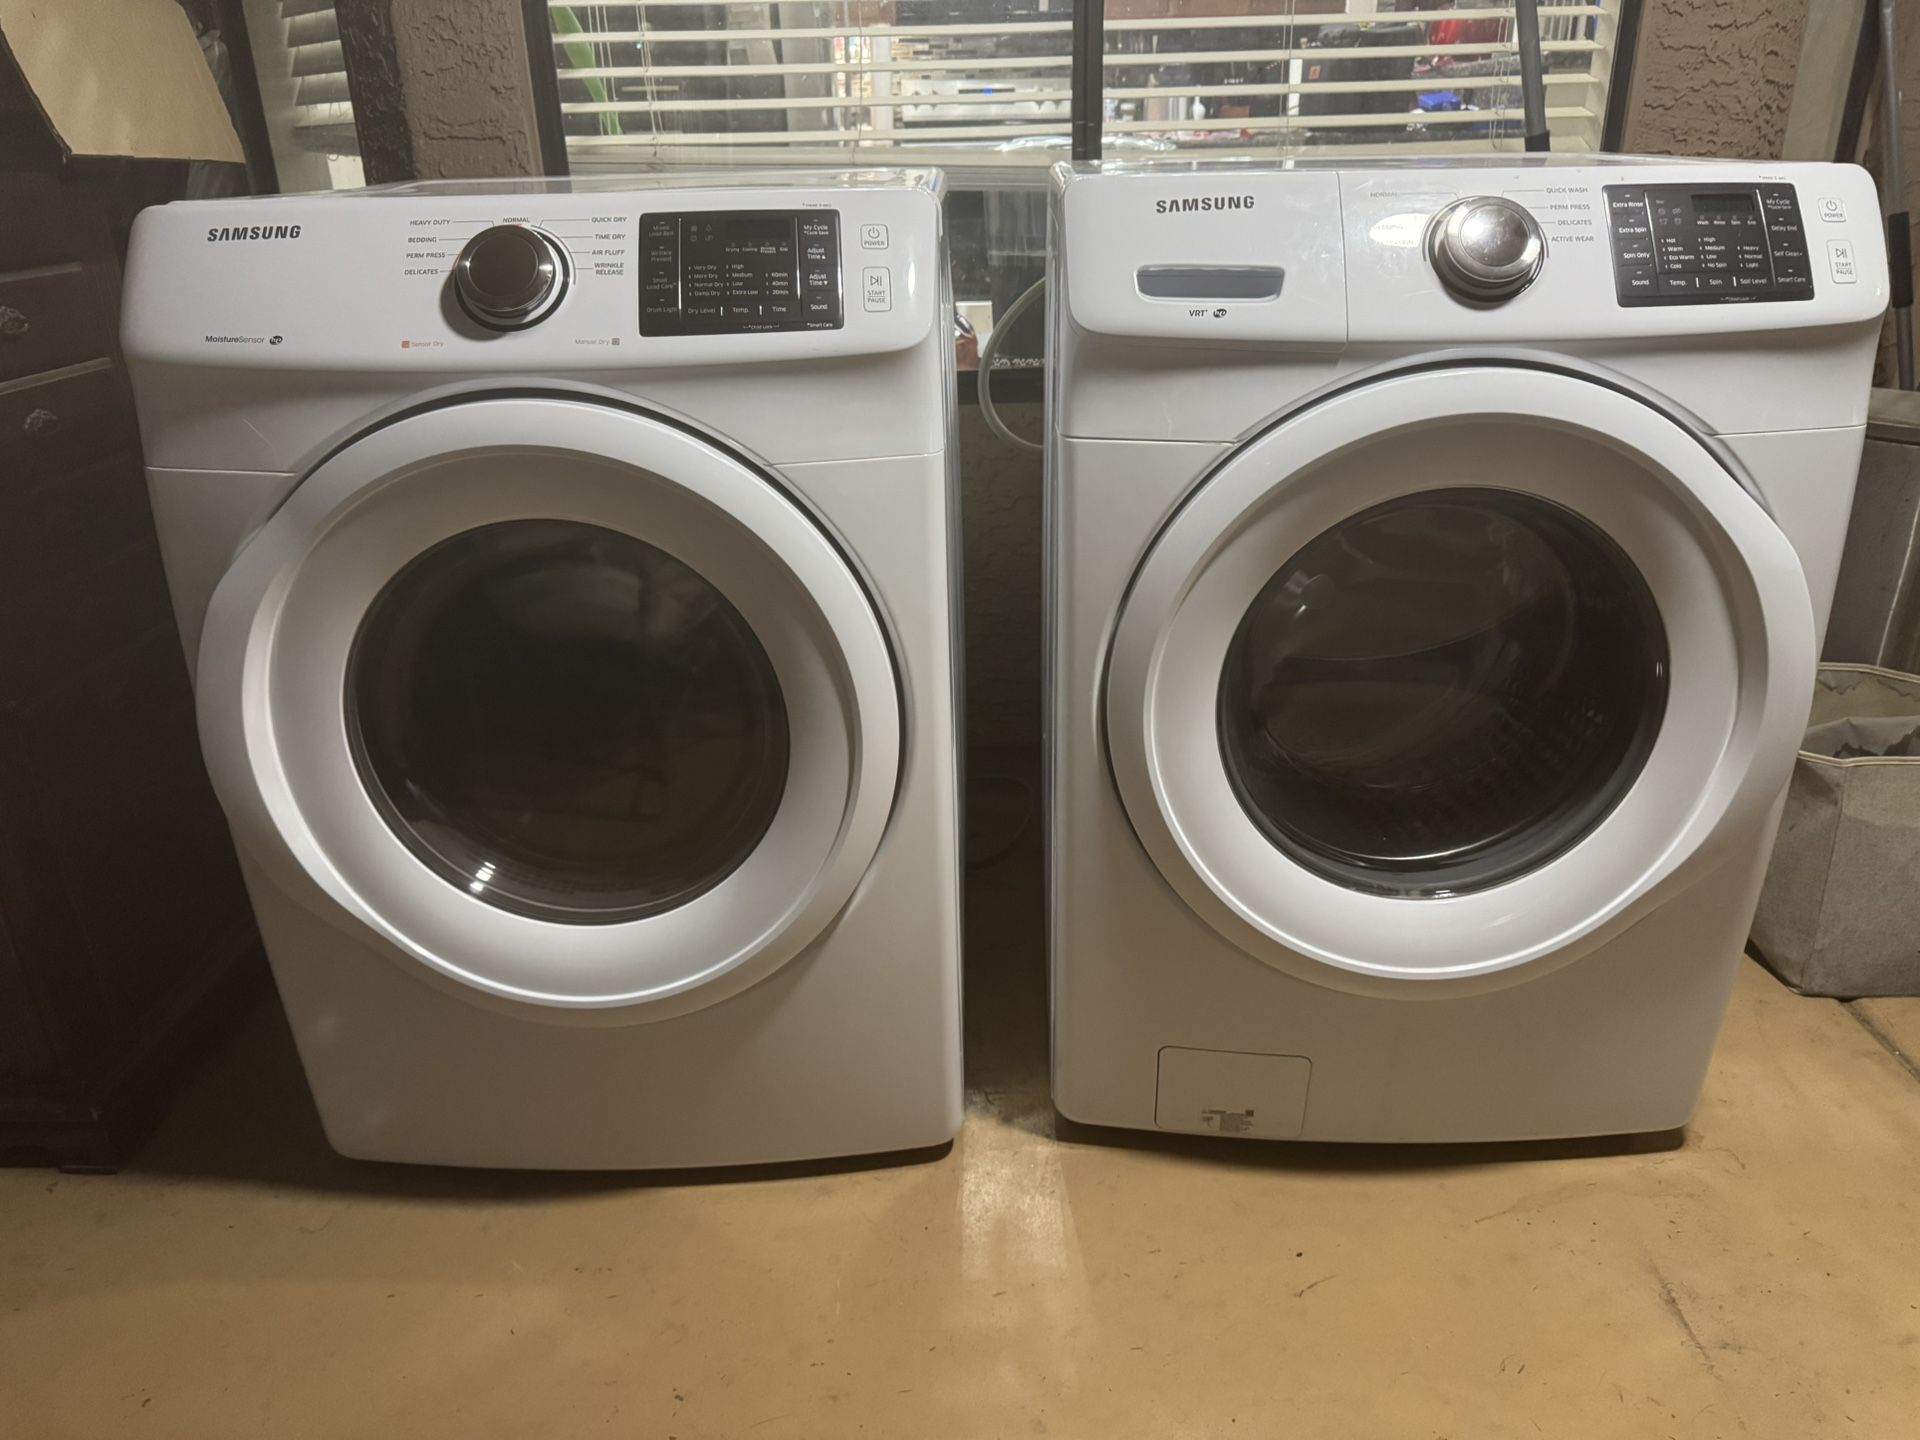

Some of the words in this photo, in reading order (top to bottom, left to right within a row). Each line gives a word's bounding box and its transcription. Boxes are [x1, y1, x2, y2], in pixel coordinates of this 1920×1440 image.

[1156, 195, 1255, 214] SAMSUNG
[207, 225, 301, 242] SAMSUNG
[205, 335, 265, 344] MoistureSensor
[598, 338, 610, 346] Dry
